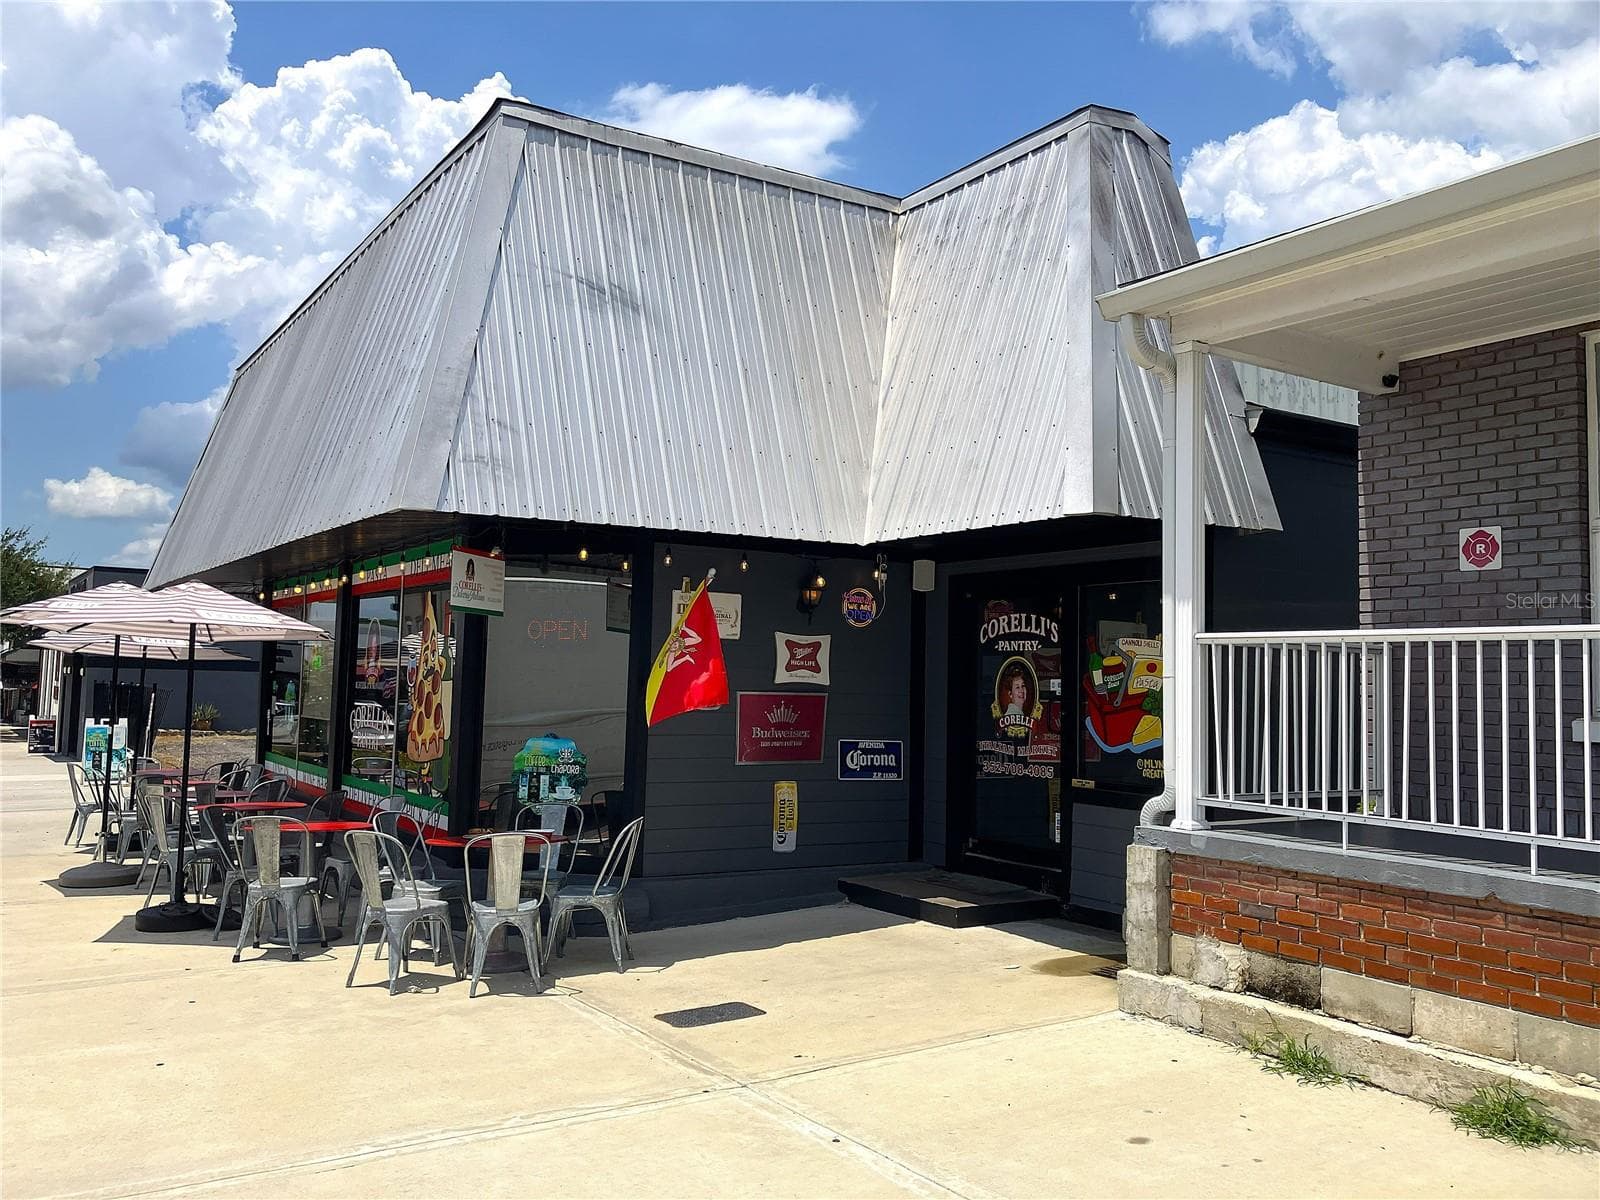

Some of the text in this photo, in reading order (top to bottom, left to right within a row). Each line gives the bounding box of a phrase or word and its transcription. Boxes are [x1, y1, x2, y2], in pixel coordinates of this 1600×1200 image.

[1475, 543, 1486, 554] R
[847, 610, 873, 621] OPEN
[528, 620, 588, 640] OPEN
[980, 613, 1059, 644] CORELLI'S
[792, 647, 814, 659] Miller
[350, 704, 390, 737] CORELLI'S
[1000, 714, 1035, 728] CORELLI
[751, 726, 810, 739] Budweiser
[979, 740, 1058, 757] ITALIAN MARKET
[846, 750, 896, 771] Corona
[776, 798, 788, 845] Corona
